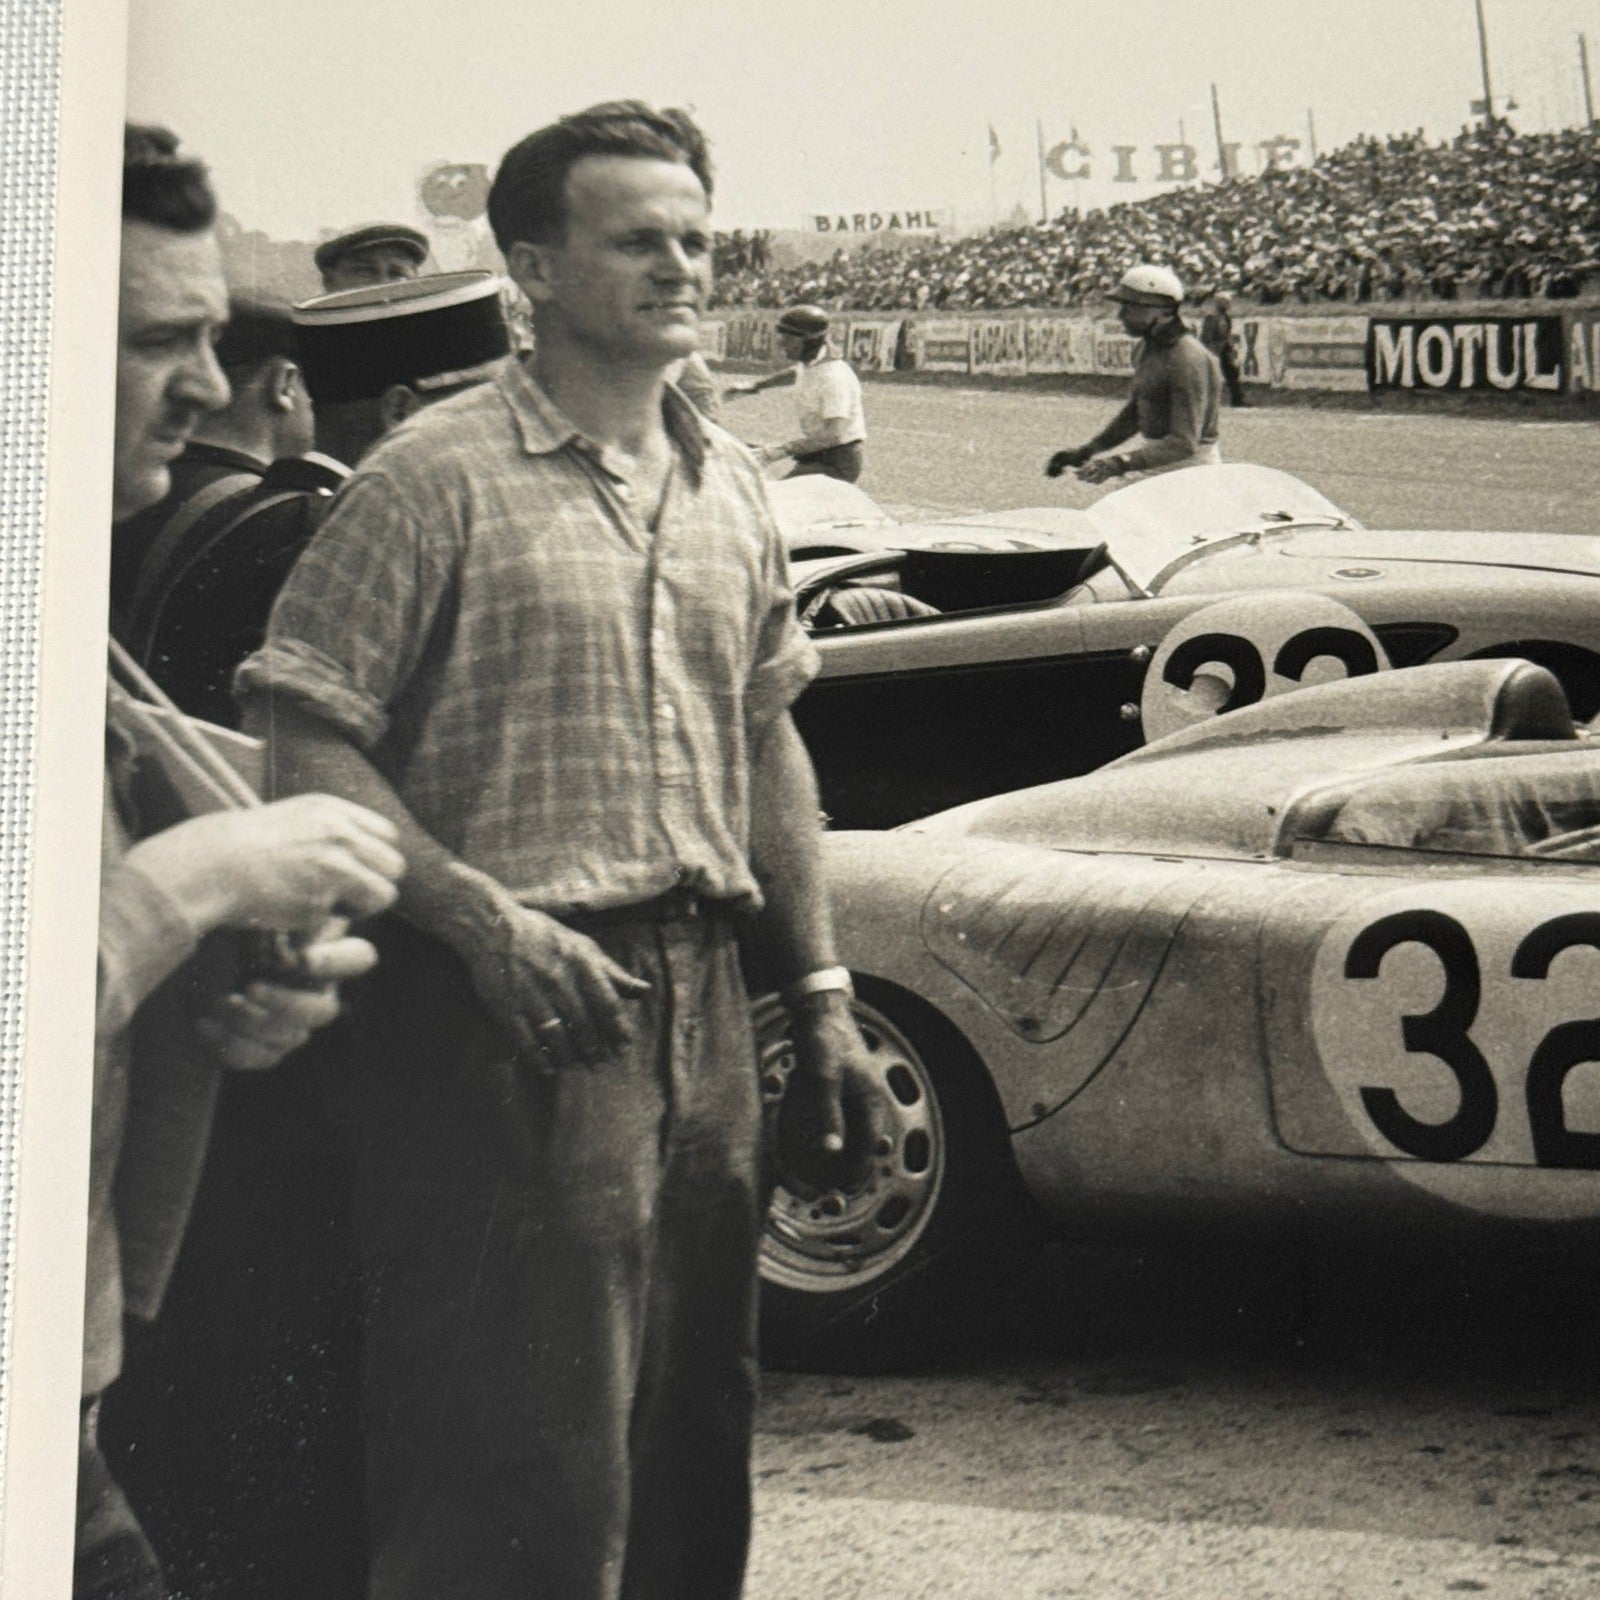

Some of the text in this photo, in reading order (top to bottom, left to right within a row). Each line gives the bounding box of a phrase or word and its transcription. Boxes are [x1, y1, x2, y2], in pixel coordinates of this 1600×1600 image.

[815, 211, 939, 232] BARDAHL
[1373, 323, 1559, 390] MOTUL
[1345, 908, 1600, 1170] 32
